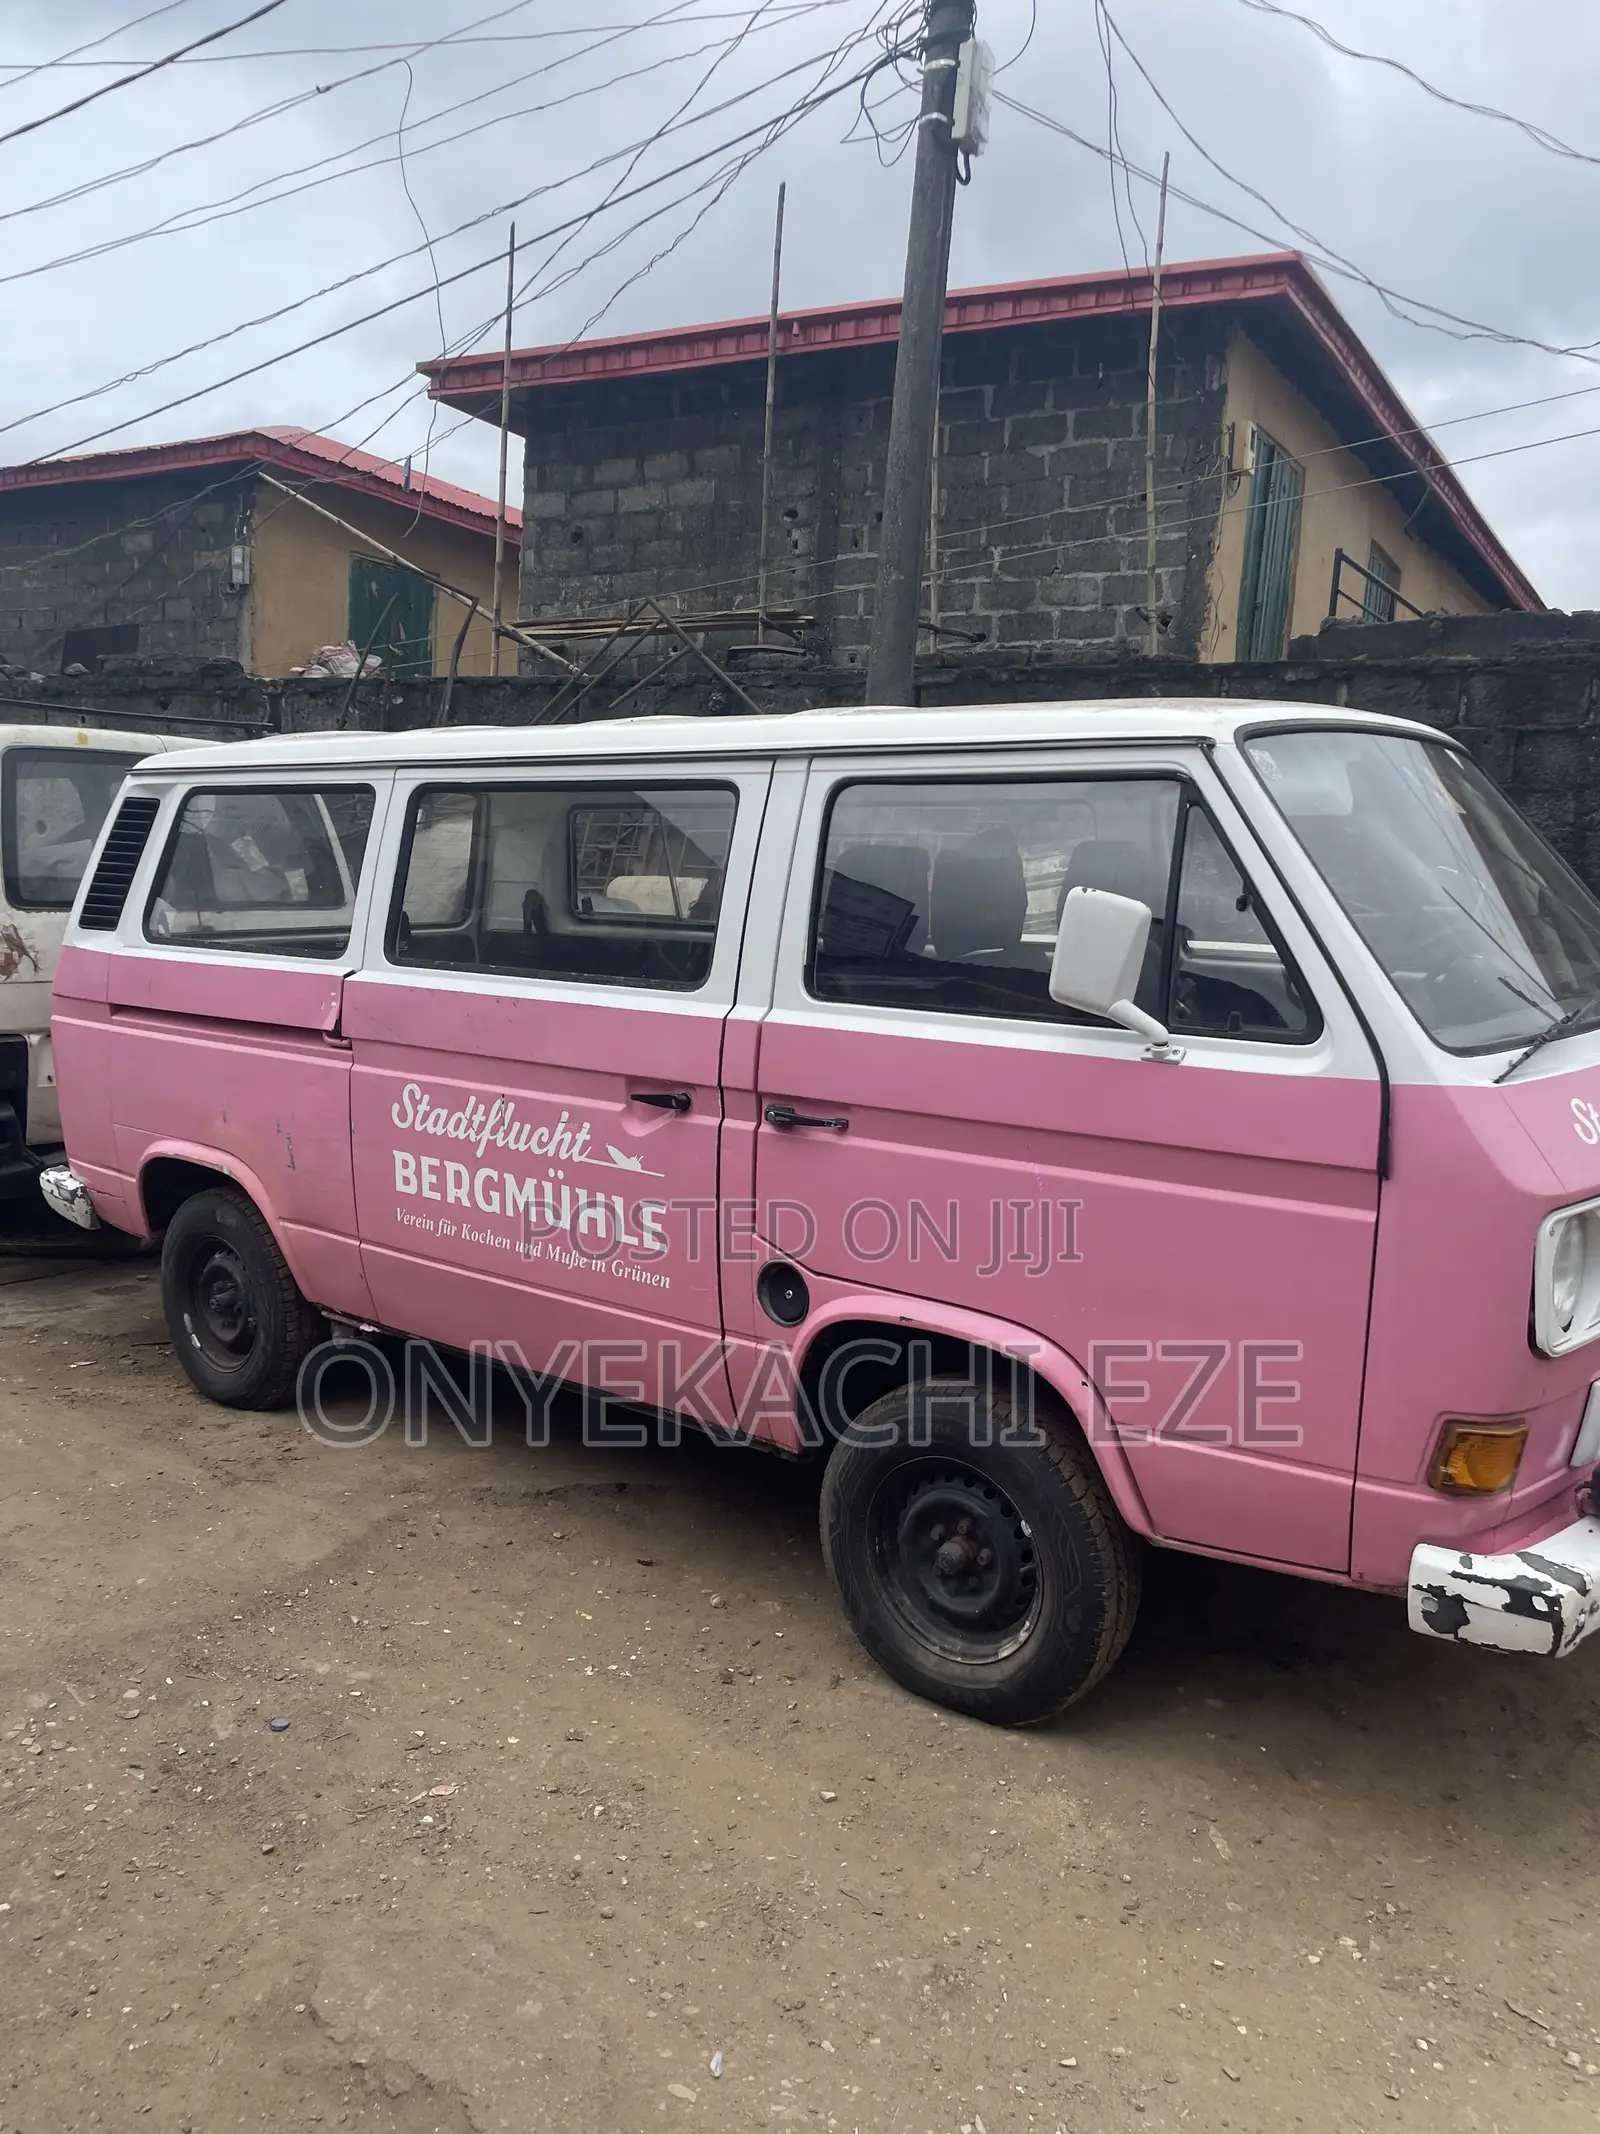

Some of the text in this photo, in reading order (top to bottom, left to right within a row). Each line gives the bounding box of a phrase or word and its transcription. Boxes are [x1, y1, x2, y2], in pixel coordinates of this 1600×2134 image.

[392, 1083, 592, 1163] Stadtflucht
[393, 1150, 669, 1252] BERGMÜHLE
[397, 1207, 671, 1289] Verein für Kochen und Muße in Grünen
